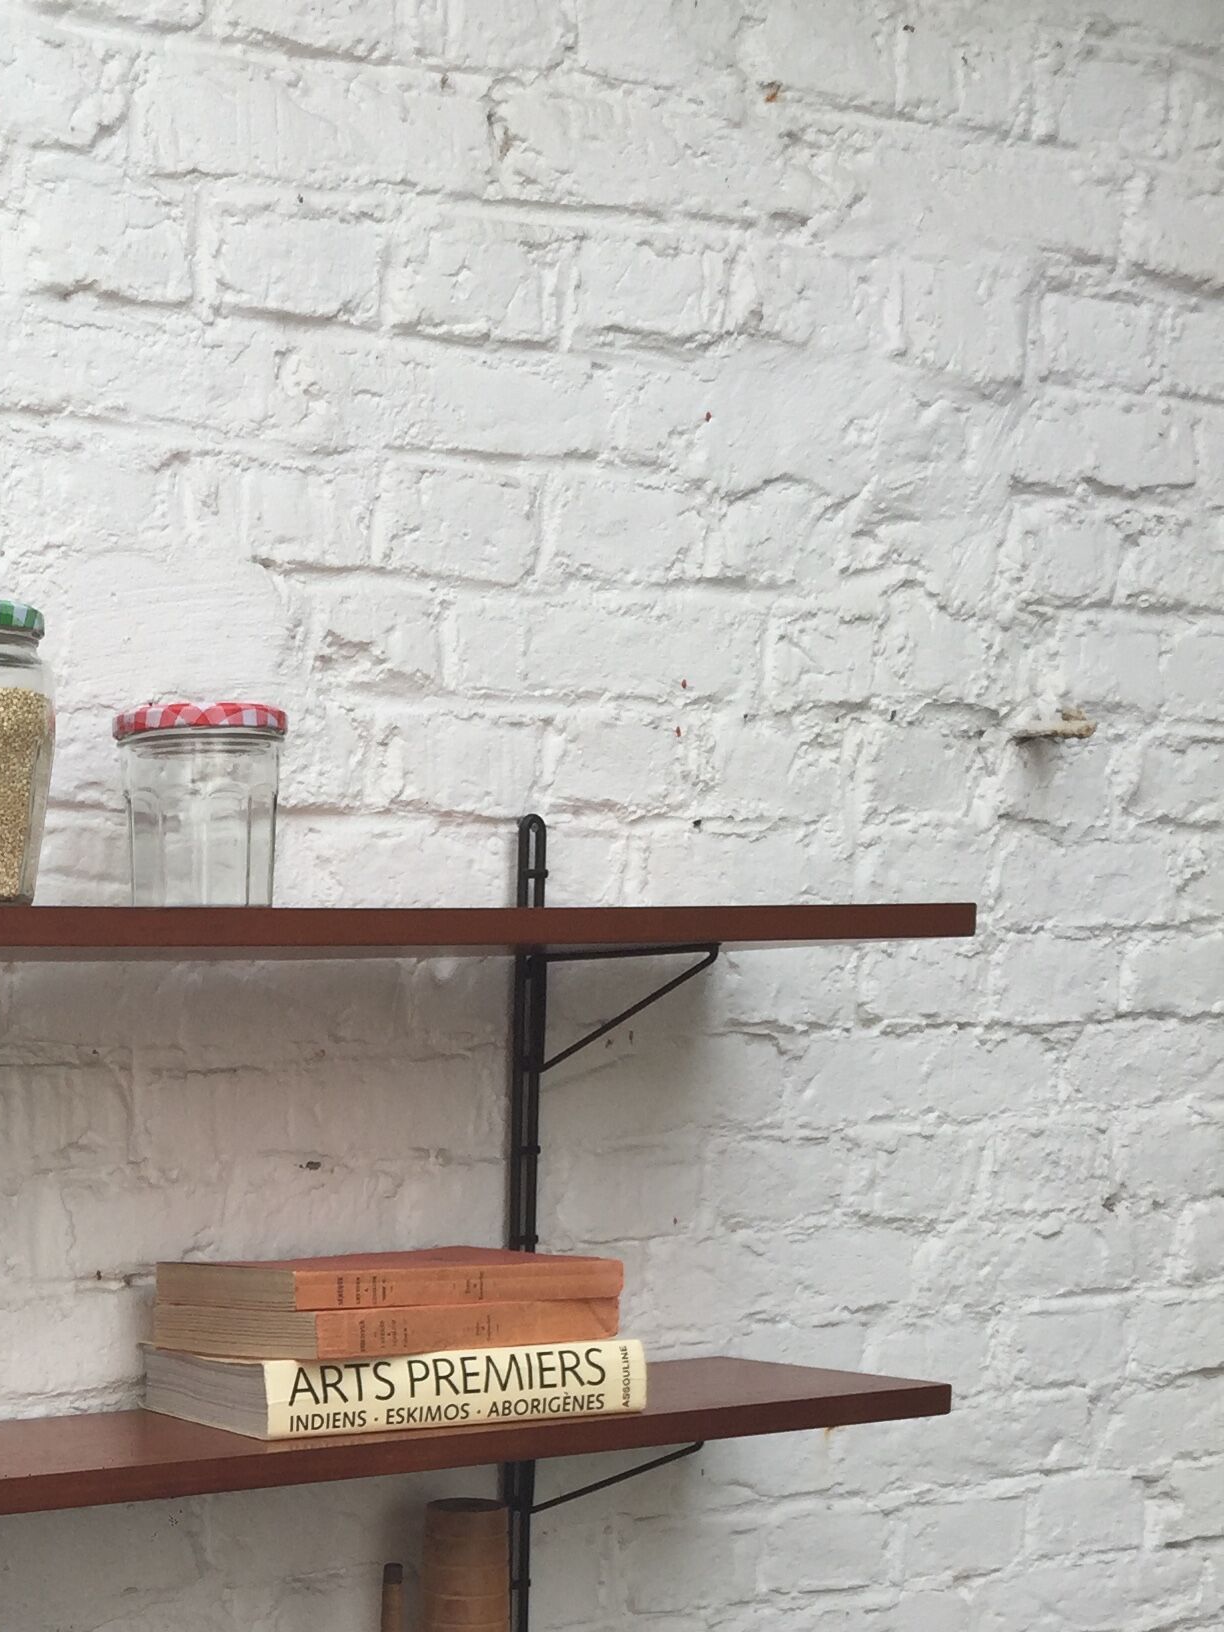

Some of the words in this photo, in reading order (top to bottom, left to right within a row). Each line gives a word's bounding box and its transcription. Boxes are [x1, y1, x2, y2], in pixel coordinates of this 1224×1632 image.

[288, 1361, 395, 1406] ARTS
[407, 1347, 606, 1398] PREMIERS
[619, 1345, 630, 1408] ASSOULINE
[289, 1410, 367, 1432] INDIENS
[386, 1402, 471, 1425] ESKIMOS
[487, 1392, 605, 1418] ABORIGÈNES
